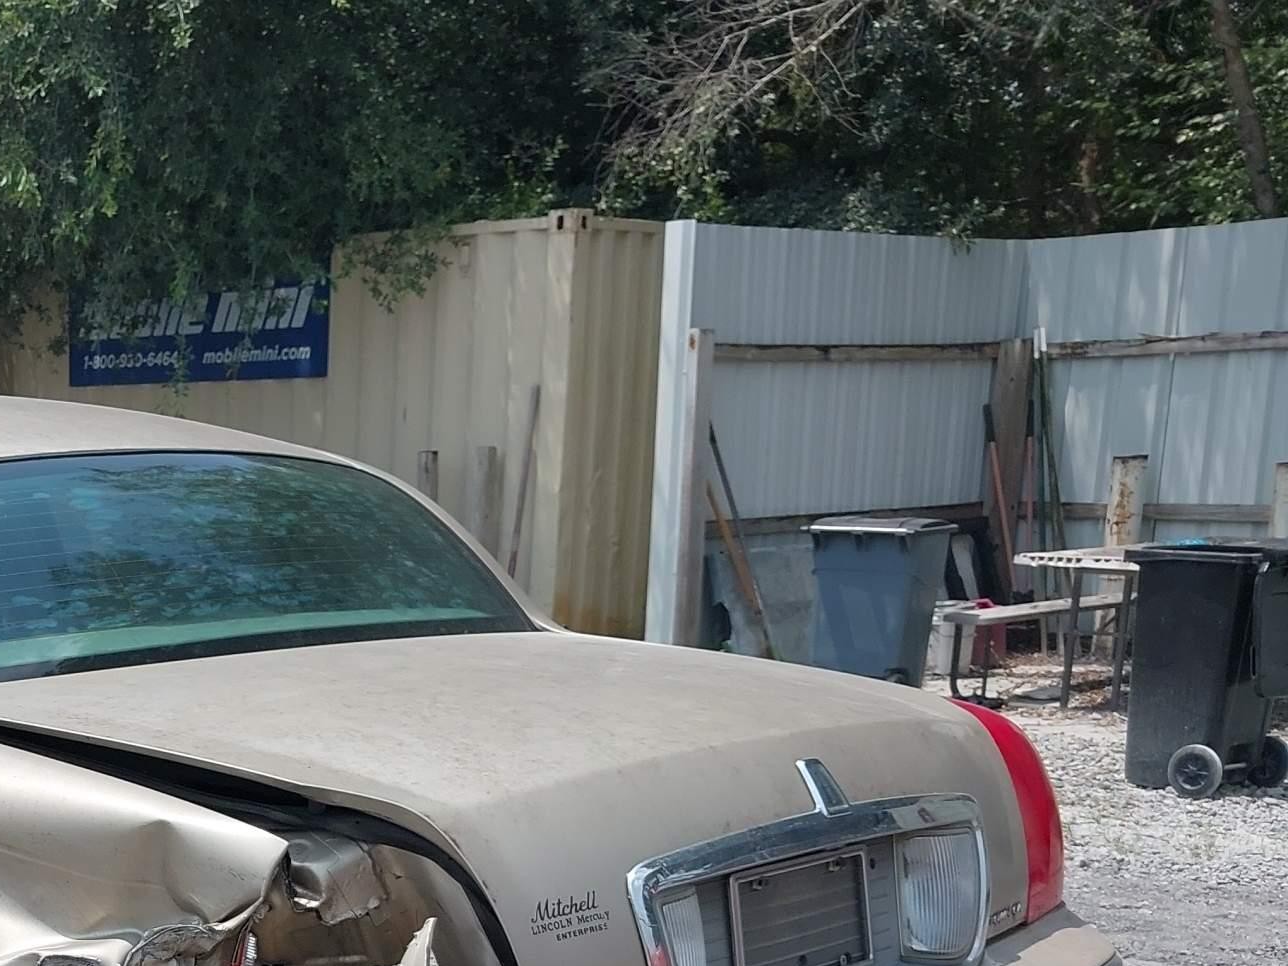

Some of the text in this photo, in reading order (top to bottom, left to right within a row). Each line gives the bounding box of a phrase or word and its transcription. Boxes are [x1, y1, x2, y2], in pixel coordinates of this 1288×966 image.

[531, 890, 599, 923] Mitchell
[531, 917, 573, 935] LINCOLN
[556, 922, 609, 941] ENTERPRISE
